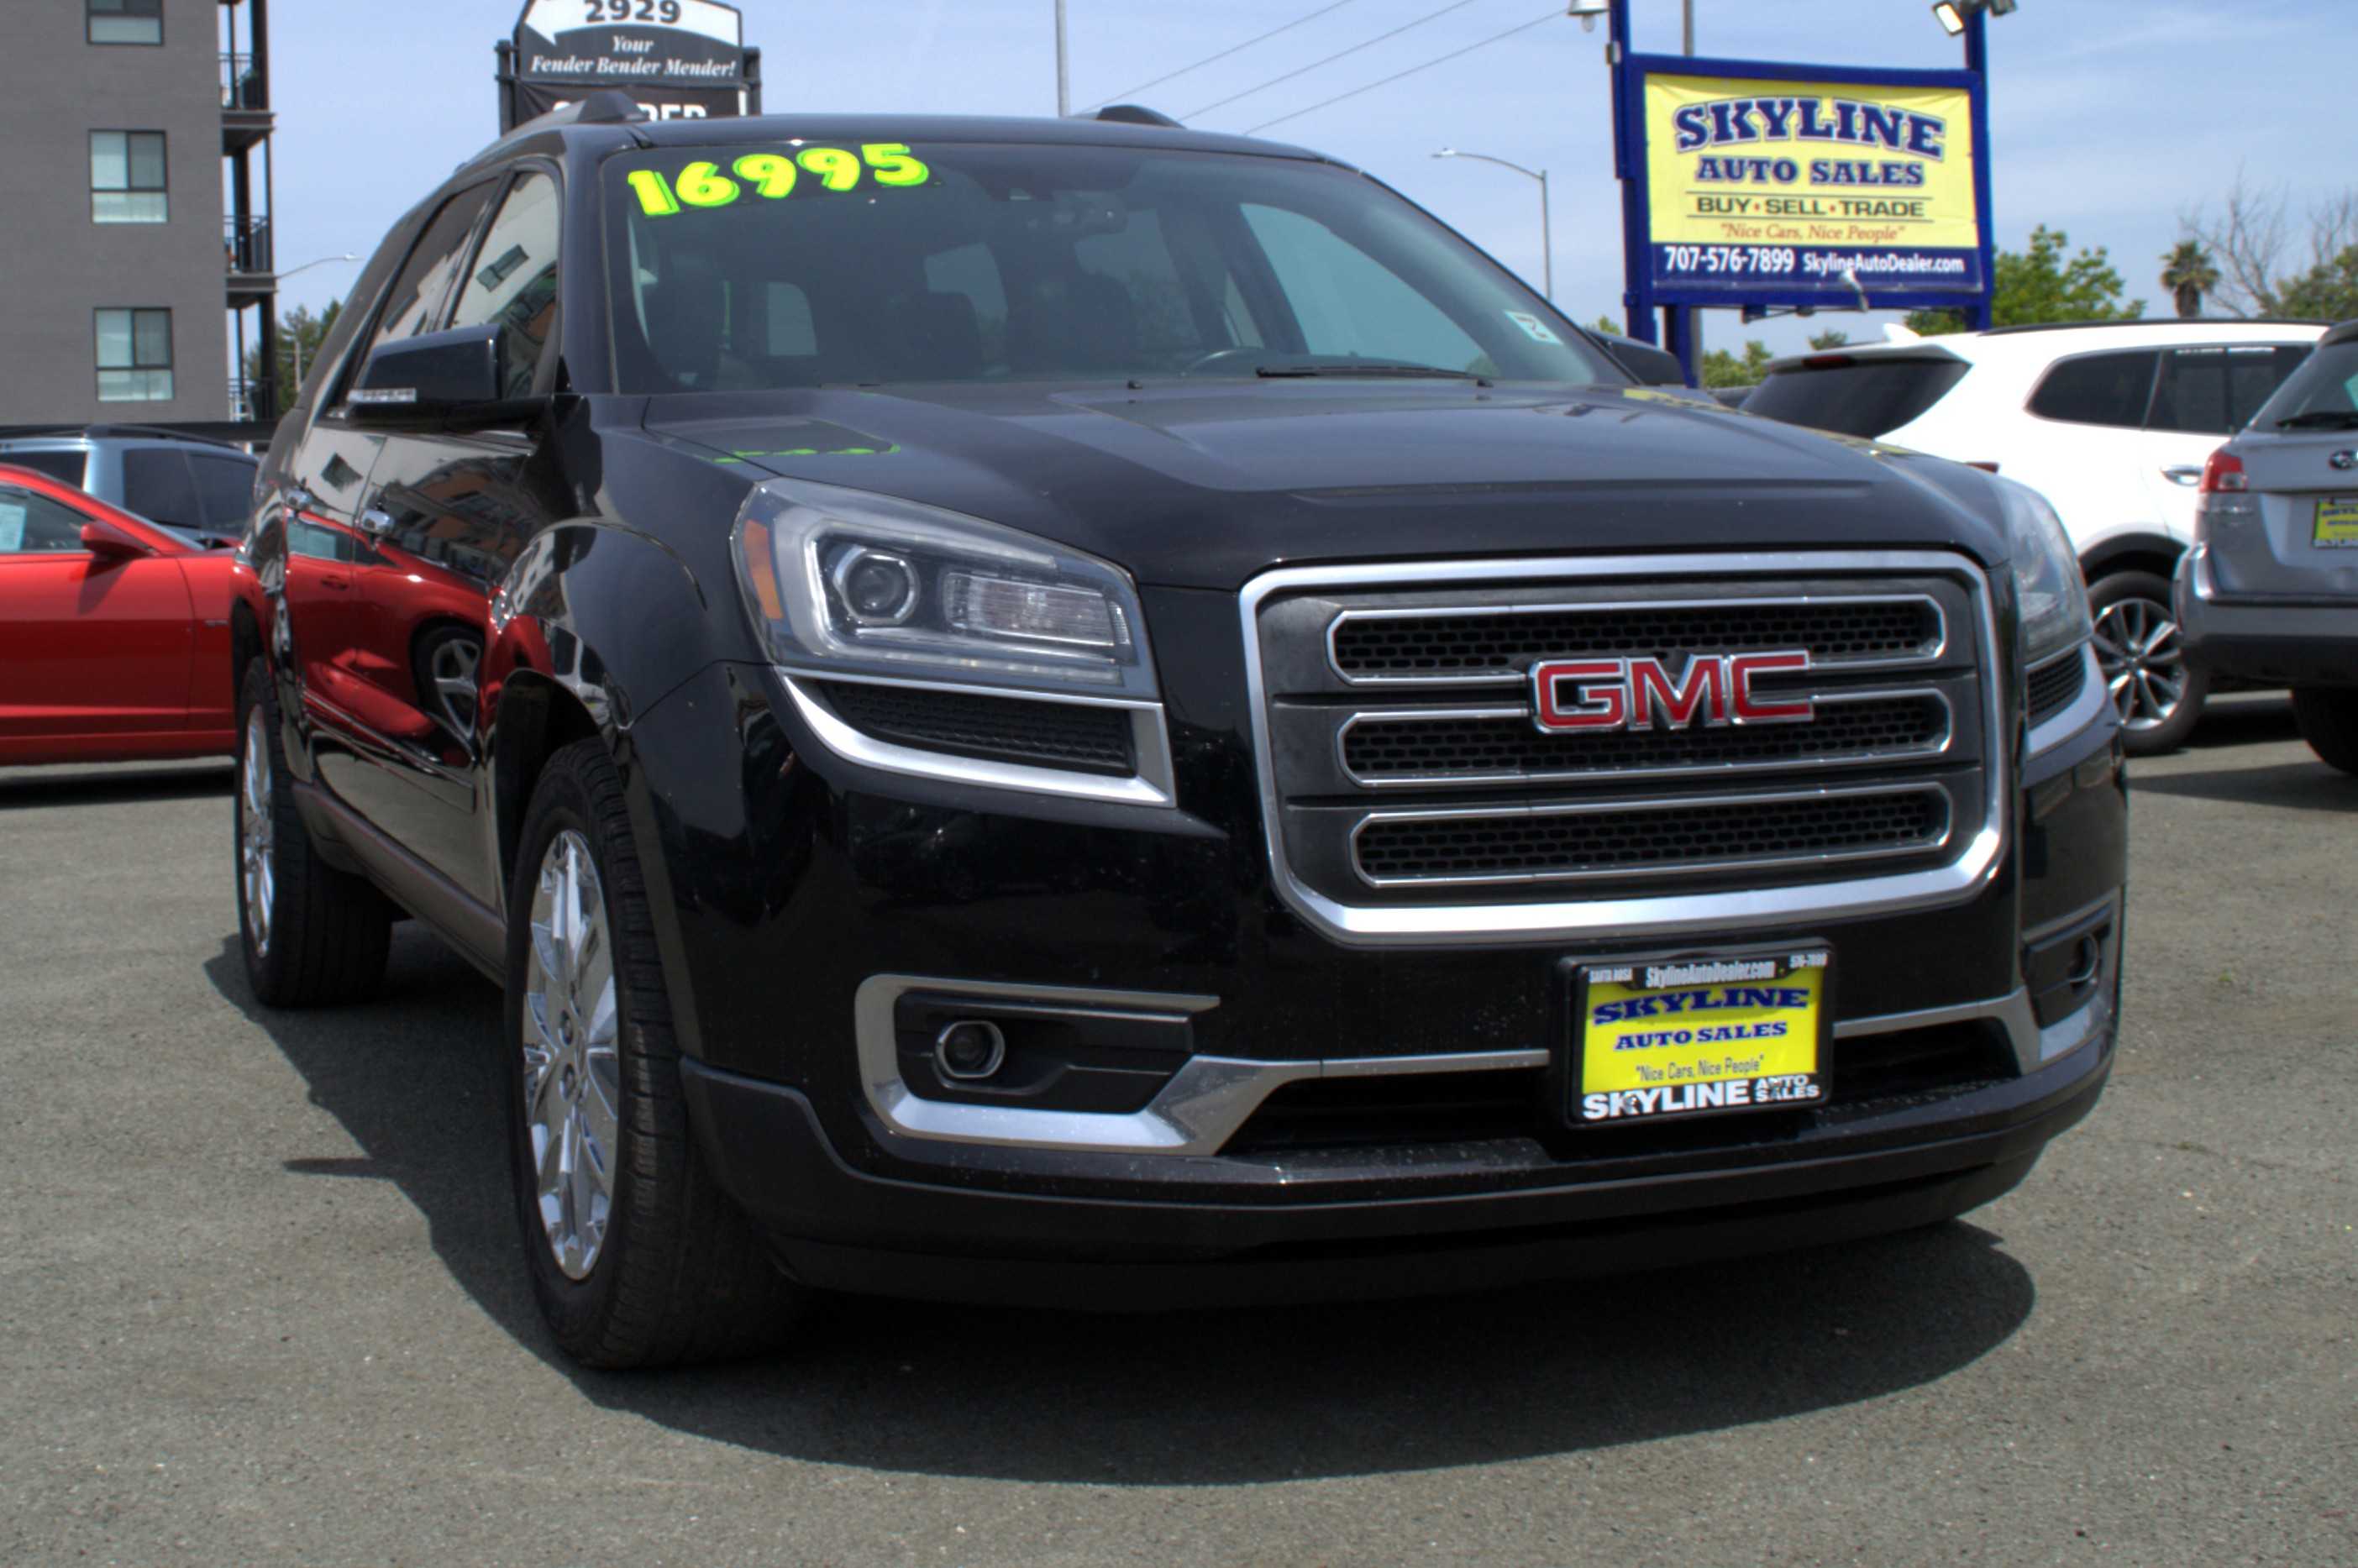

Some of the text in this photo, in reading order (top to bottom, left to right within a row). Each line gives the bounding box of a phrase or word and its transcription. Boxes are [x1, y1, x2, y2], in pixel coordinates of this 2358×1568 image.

[585, 0, 681, 24] 2929
[612, 35, 654, 52] Your
[531, 55, 737, 76] Fender Bender Mender!
[1673, 95, 1946, 162] SKYLINE
[628, 143, 929, 216] 16995
[1695, 155, 1925, 186] AUTO SALES
[1696, 197, 1925, 217] BUY SELL TRADE
[1766, 223, 1804, 239] Cars,
[1809, 225, 1842, 239] Nice
[1664, 246, 1964, 276] 707-576-7899 SkylineAutoDealer.com
[1529, 650, 1814, 733] GMC
[1593, 988, 1810, 1025] SKYLINE
[1614, 1021, 1788, 1050] AUTO SALES
[1698, 1059, 1721, 1076] Nice
[1755, 1084, 1820, 1102] SALES
[1756, 1074, 1809, 1090] AUTO
[1583, 1079, 1750, 1120] SKYLINE
